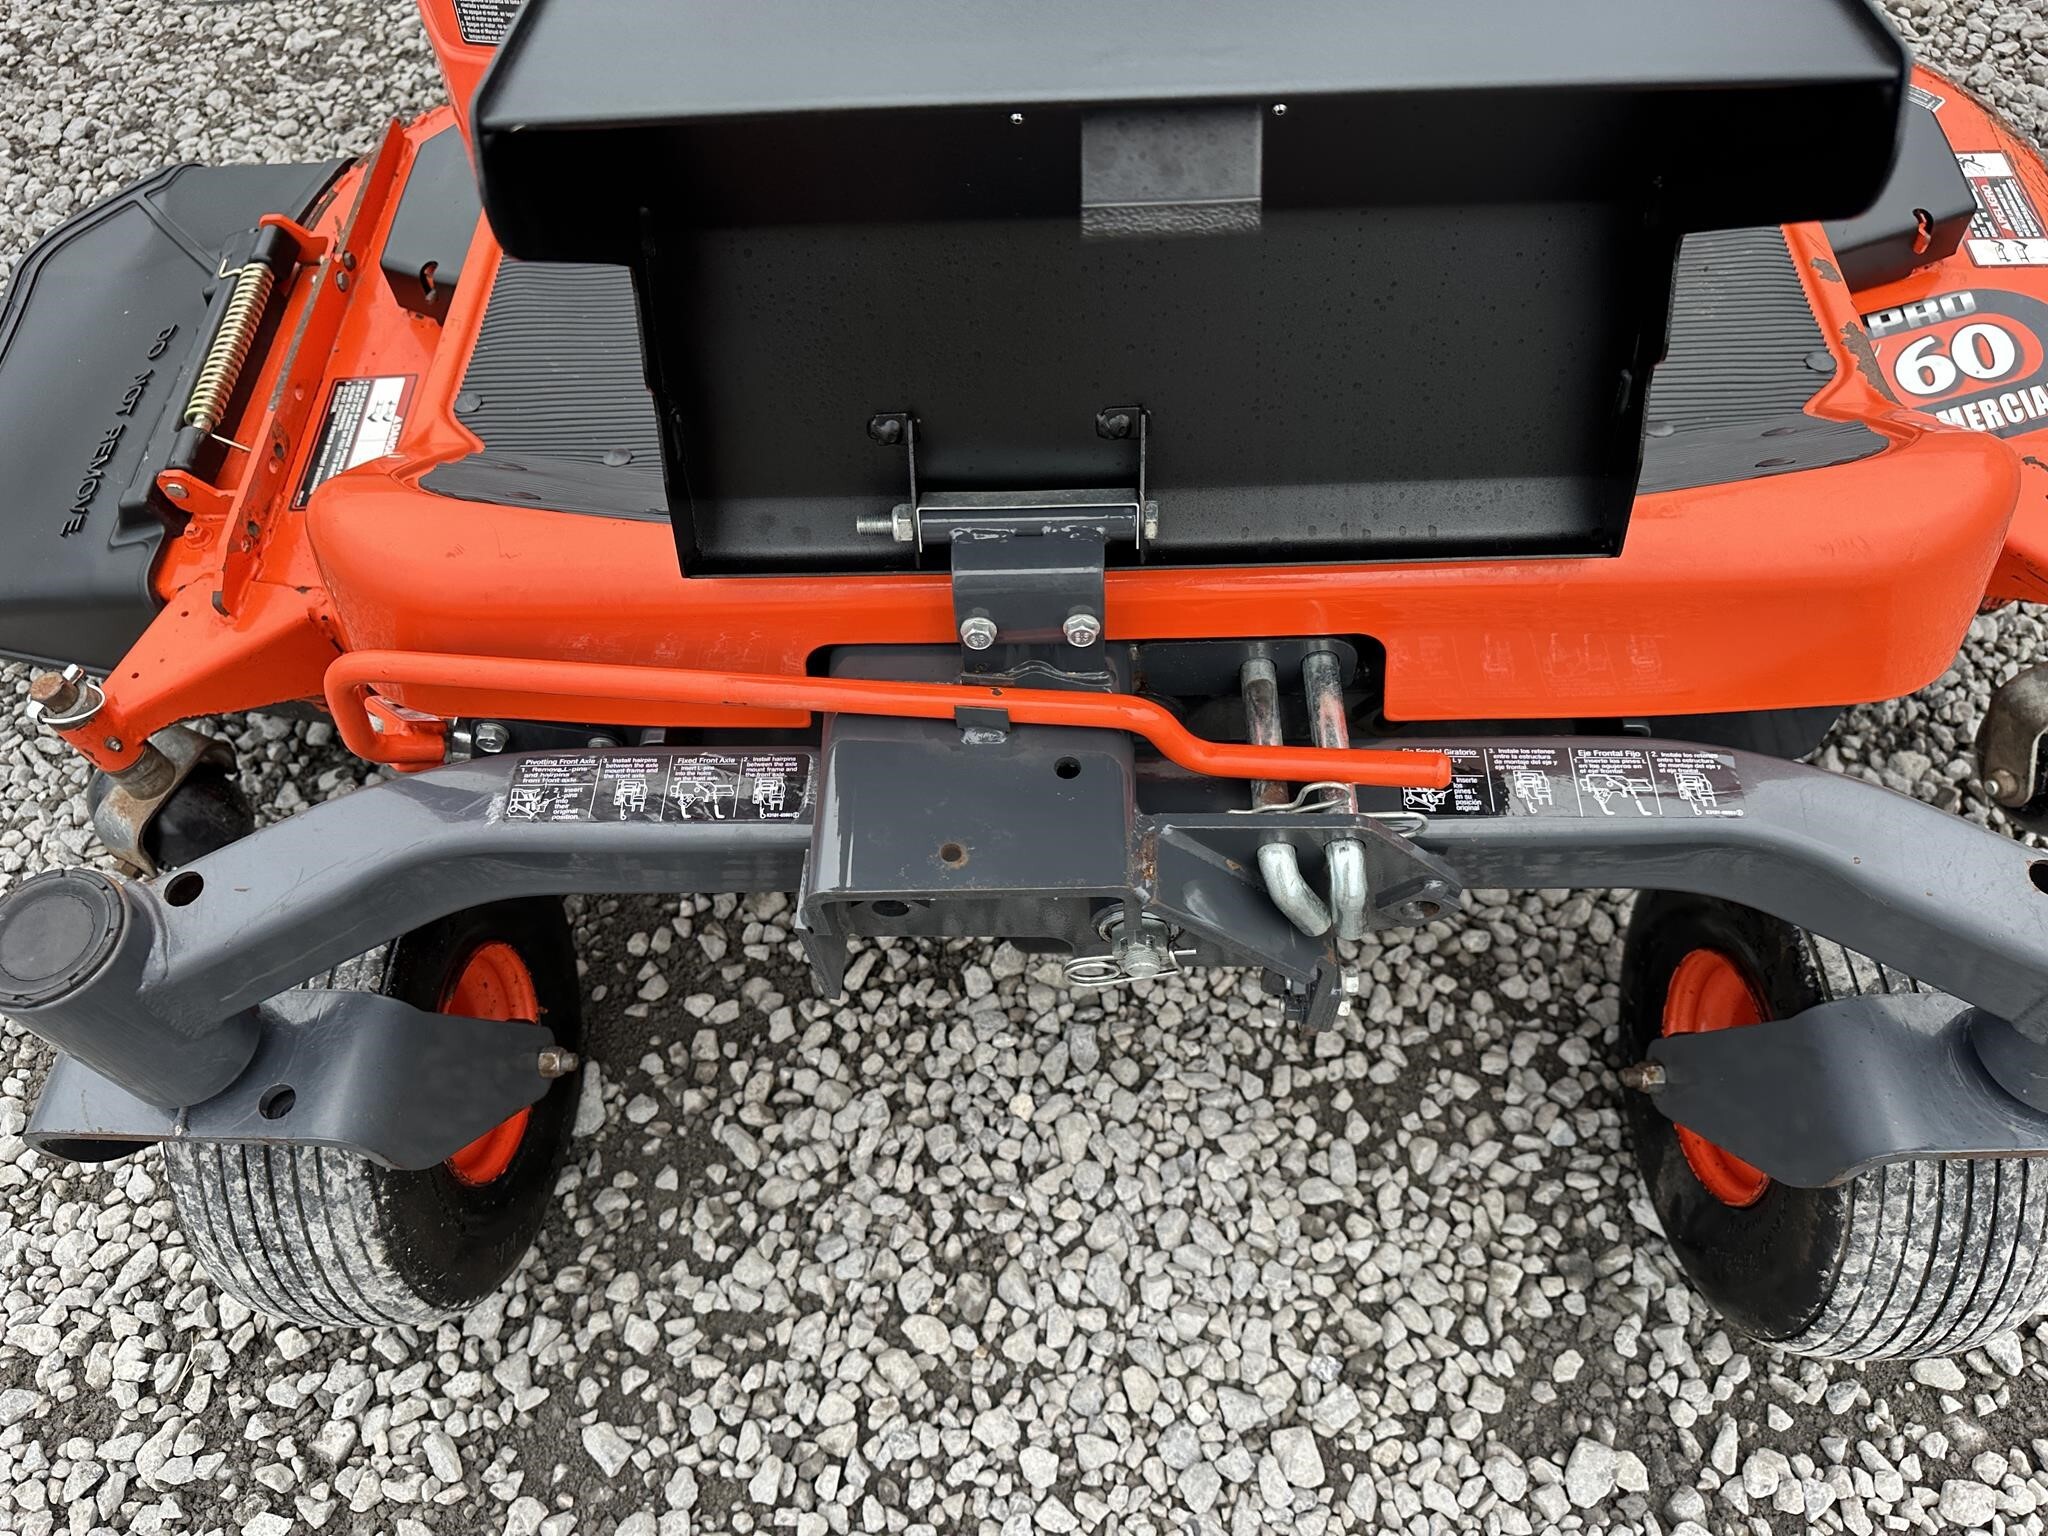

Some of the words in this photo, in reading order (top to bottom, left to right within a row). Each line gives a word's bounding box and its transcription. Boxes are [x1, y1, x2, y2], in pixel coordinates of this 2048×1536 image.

[1867, 291, 1976, 338] PRO
[147, 324, 180, 361] DO
[1894, 323, 2016, 395] 60
[115, 368, 154, 417] NOT
[1936, 383, 2048, 432] MERCIA
[60, 423, 127, 537] REMOVE
